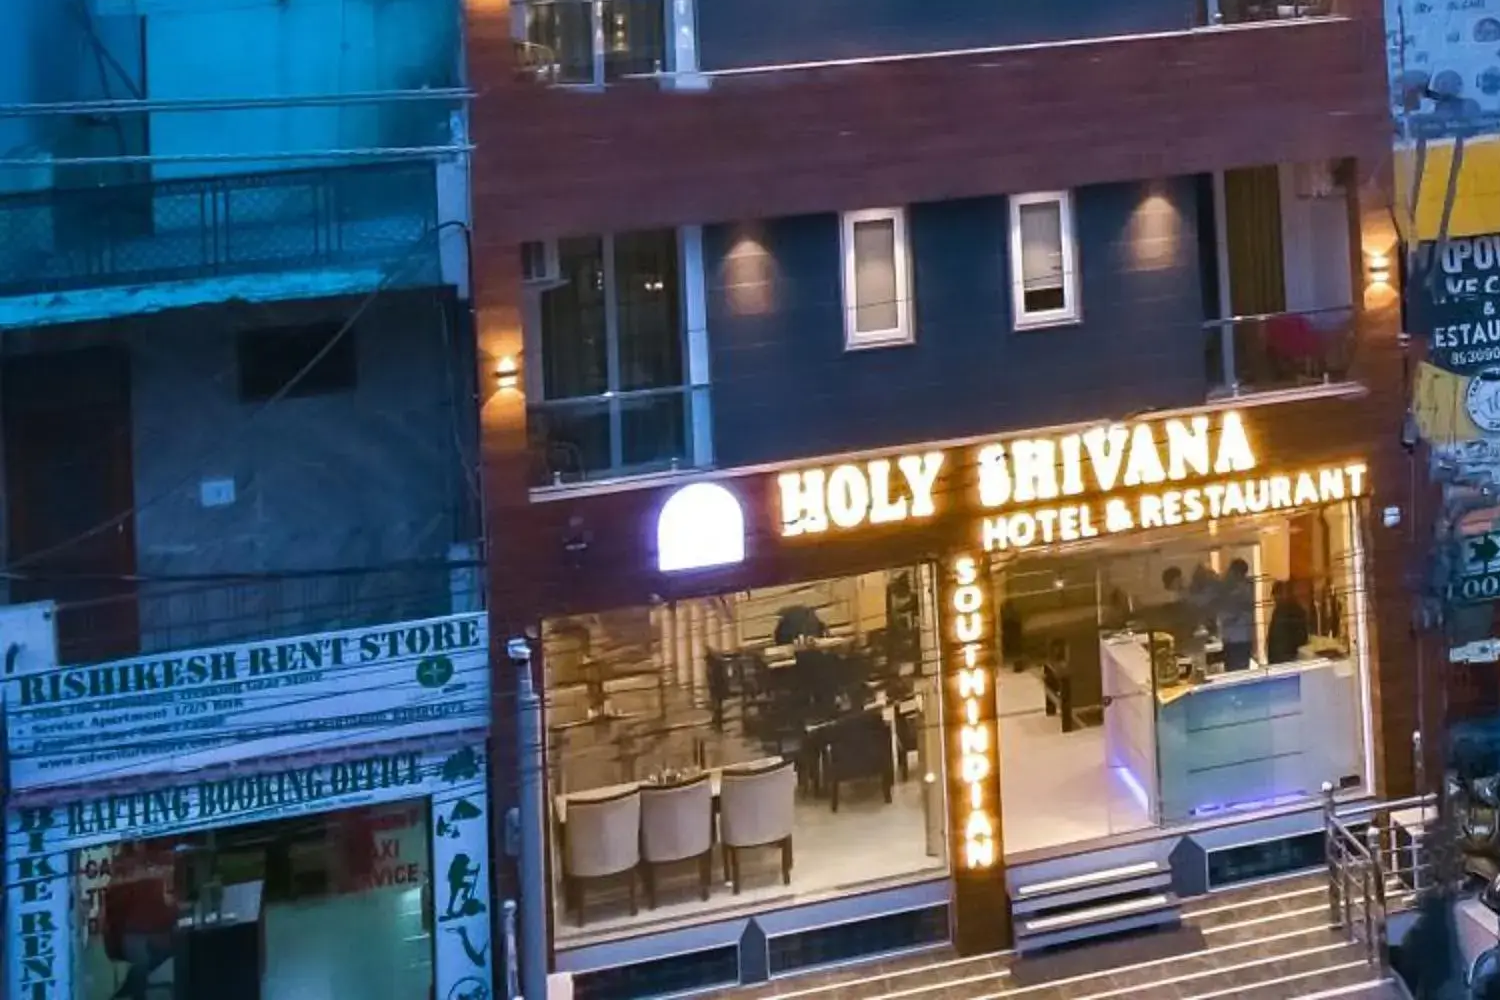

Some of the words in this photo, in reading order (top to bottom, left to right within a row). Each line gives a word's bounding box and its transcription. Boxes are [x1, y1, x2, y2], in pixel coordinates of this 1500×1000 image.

[778, 450, 945, 536] HOLY
[977, 410, 1257, 507] SHIVANA
[982, 506, 1098, 552] HOTEL
[1105, 497, 1134, 532] &
[1140, 463, 1367, 530] RESTAURANT
[19, 651, 237, 706] RISHIKESH
[248, 637, 349, 676] RENT
[360, 619, 480, 663] STORE
[31, 719, 85, 735] Service
[90, 709, 168, 730] Apartment
[68, 790, 191, 836] RAFTING
[200, 765, 323, 820] BOOKING
[331, 752, 423, 794] OFFICE
